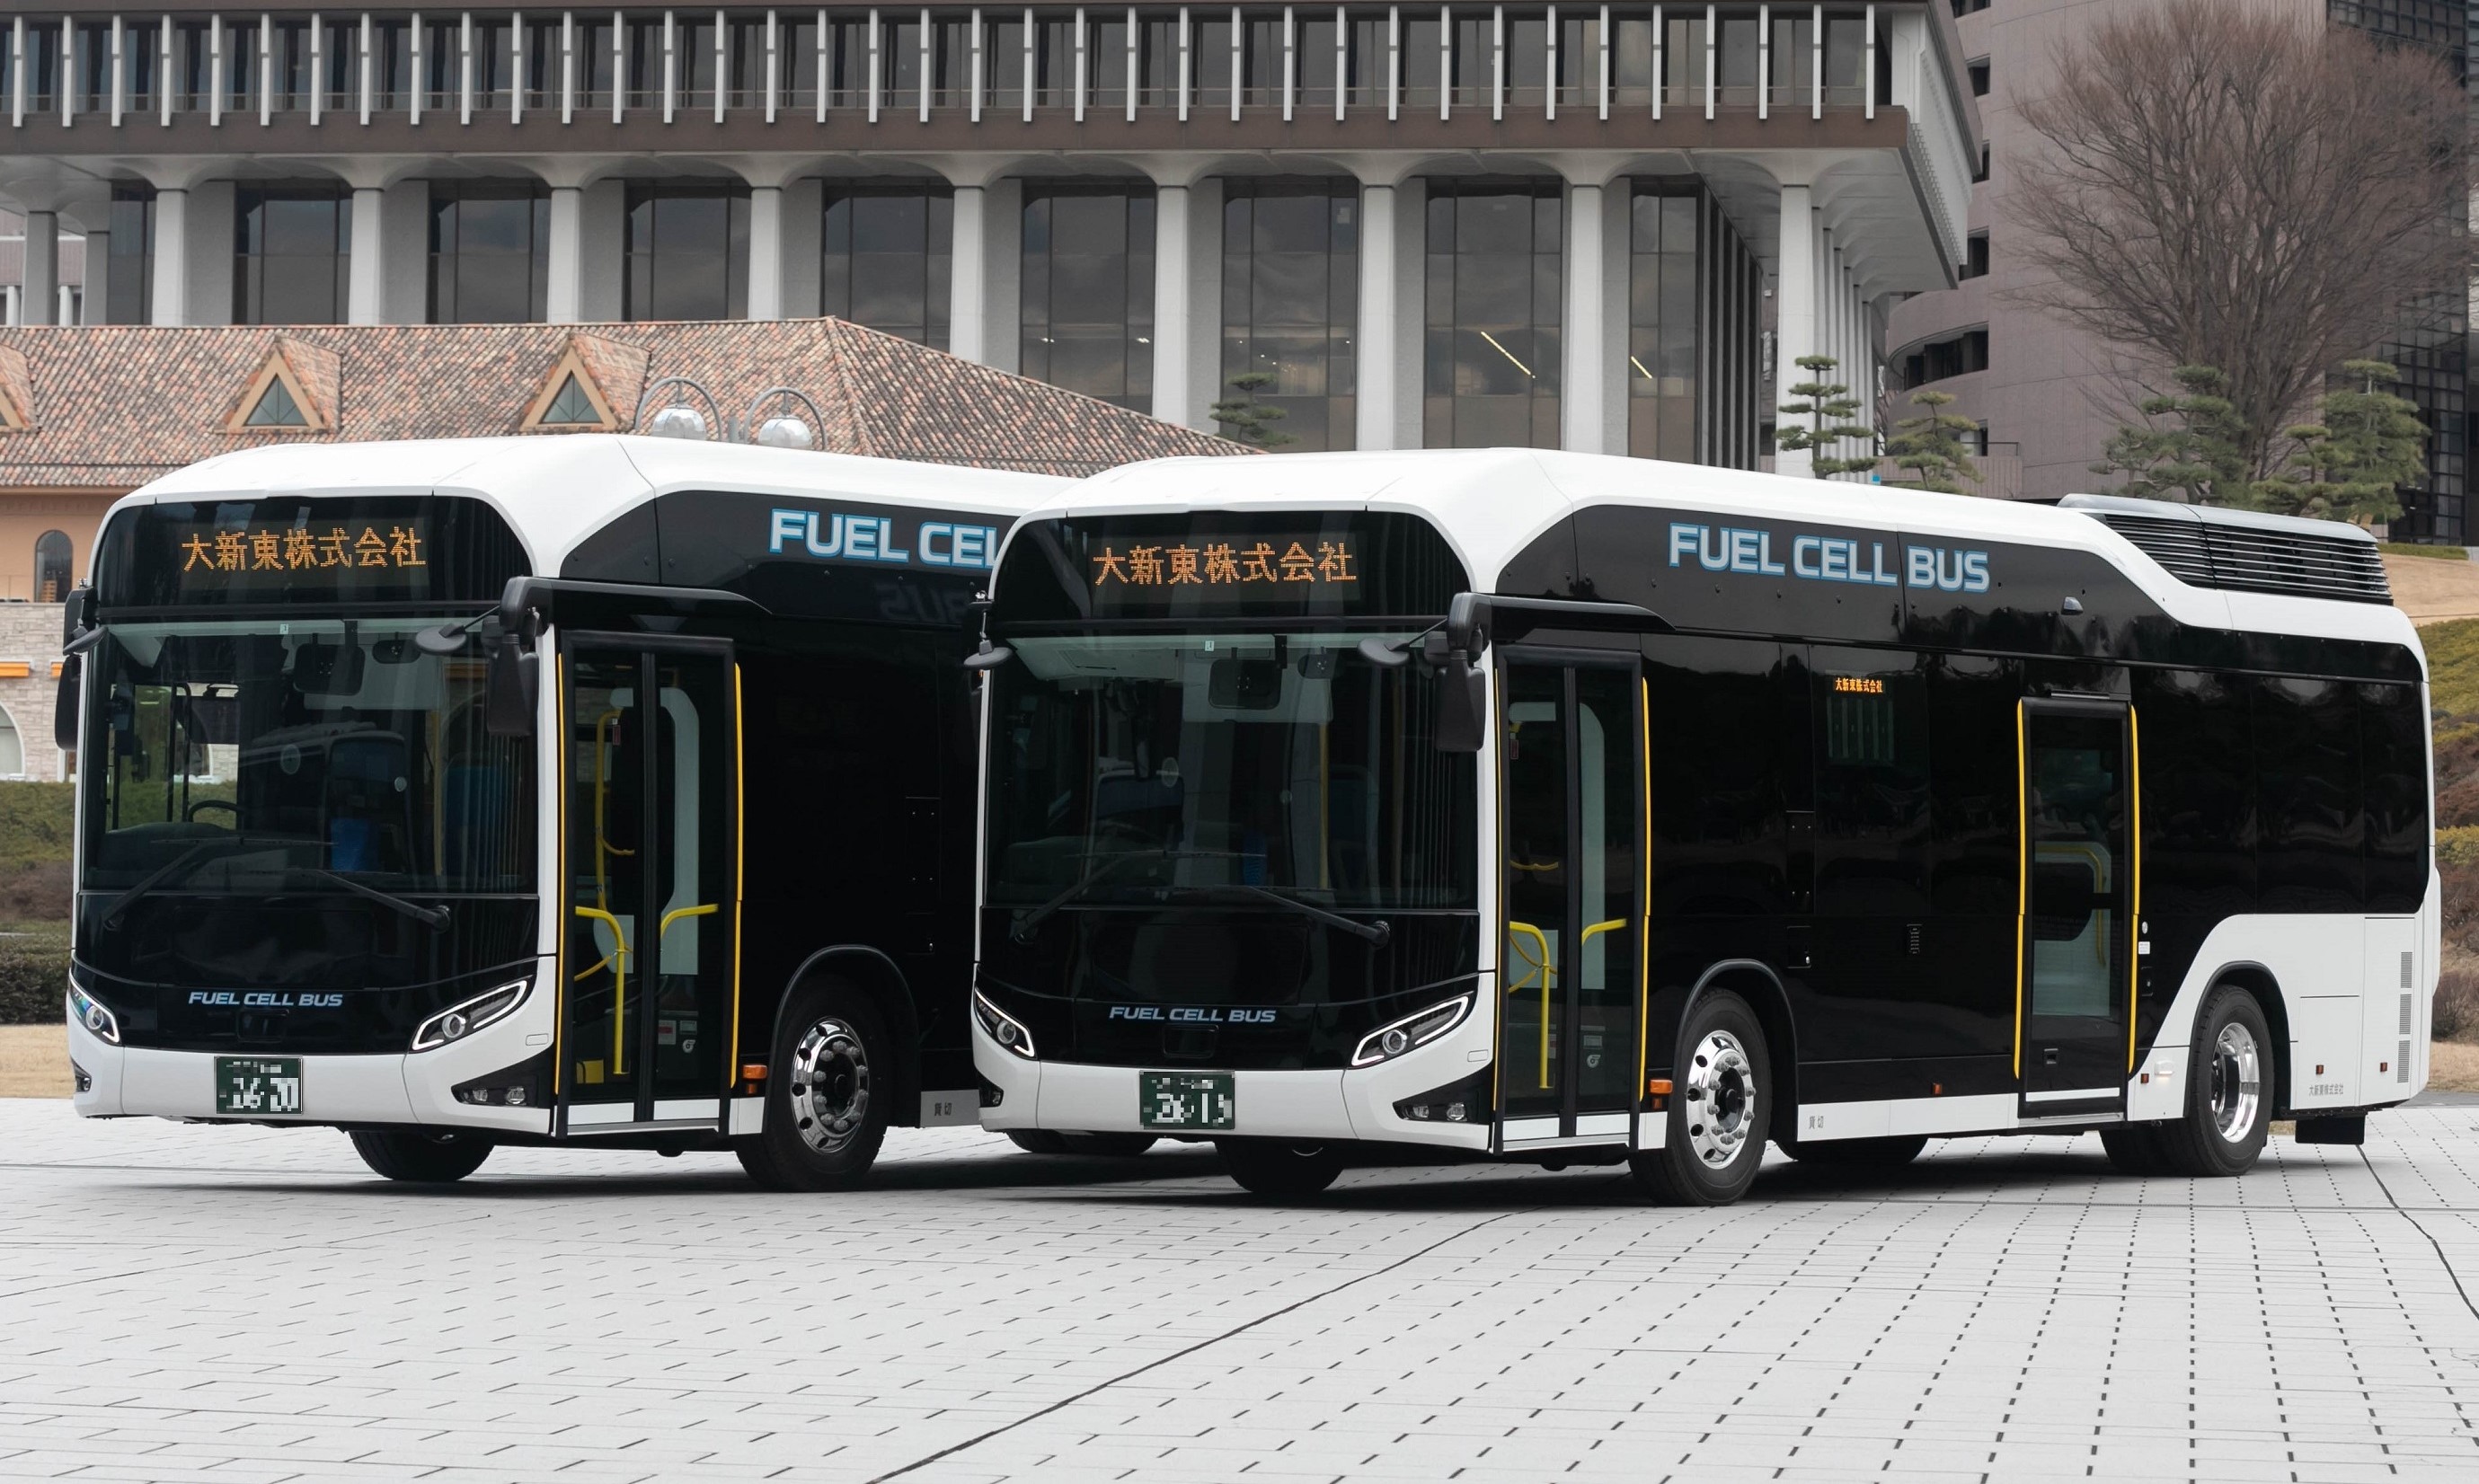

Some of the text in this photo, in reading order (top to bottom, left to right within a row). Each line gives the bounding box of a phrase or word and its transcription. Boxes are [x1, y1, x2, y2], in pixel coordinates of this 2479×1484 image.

[181, 526, 427, 572] 大新東株式会社
[769, 508, 999, 570] FUEL CEL
[1669, 522, 1990, 594] FUEL CELL BUS
[1093, 542, 1358, 586] 大新東株式会社
[1835, 676, 1883, 693] 大新東株式会社
[188, 991, 343, 1007] FUEL CELL BUS
[1109, 1006, 1277, 1023] FUEL CELL BUS
